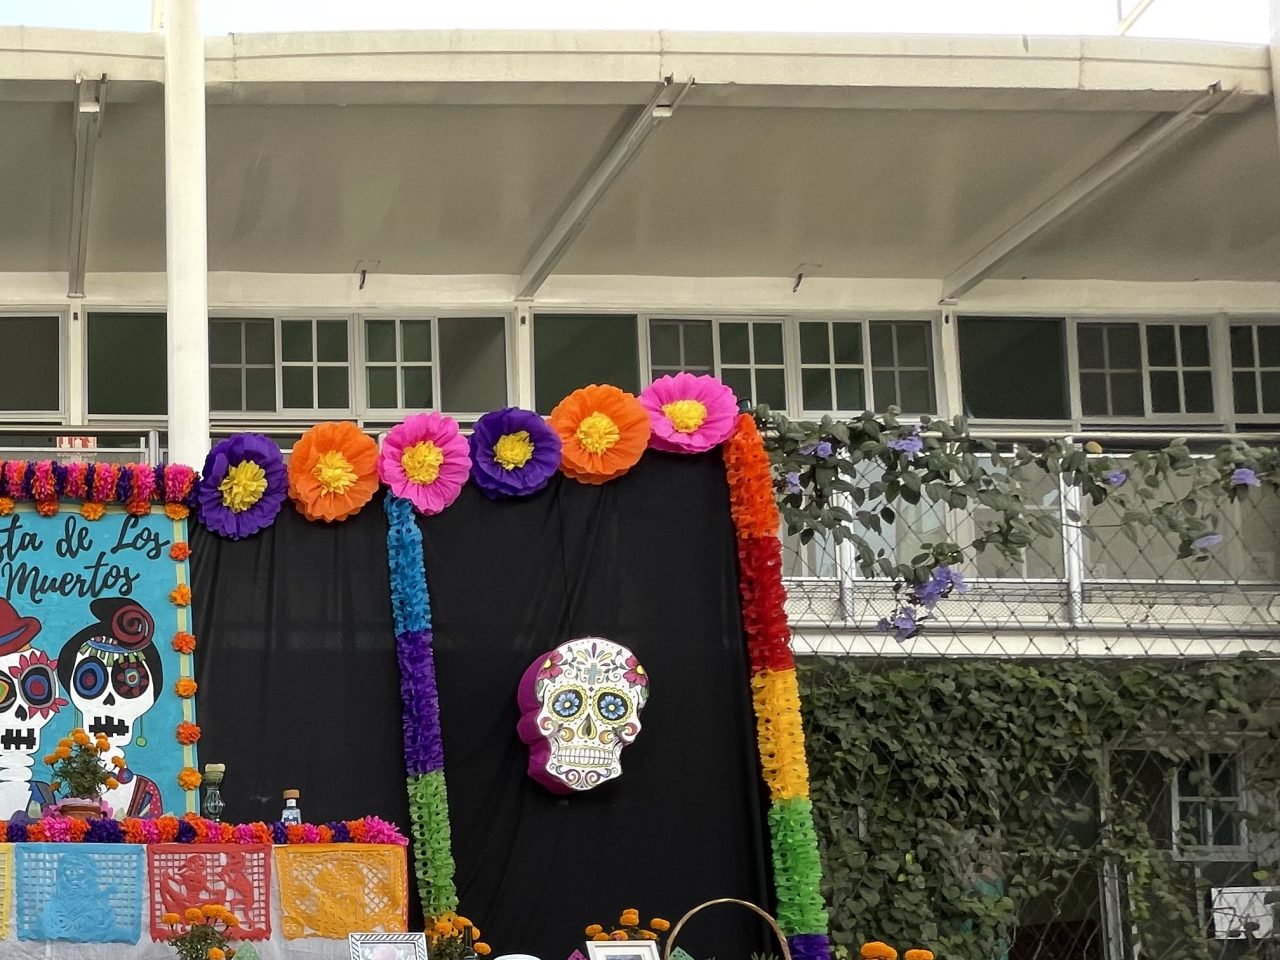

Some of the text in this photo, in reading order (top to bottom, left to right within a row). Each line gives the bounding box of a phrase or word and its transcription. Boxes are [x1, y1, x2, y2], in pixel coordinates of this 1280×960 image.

[56, 515, 93, 559] de
[111, 513, 170, 559] Los
[1, 551, 141, 604] Muertos
